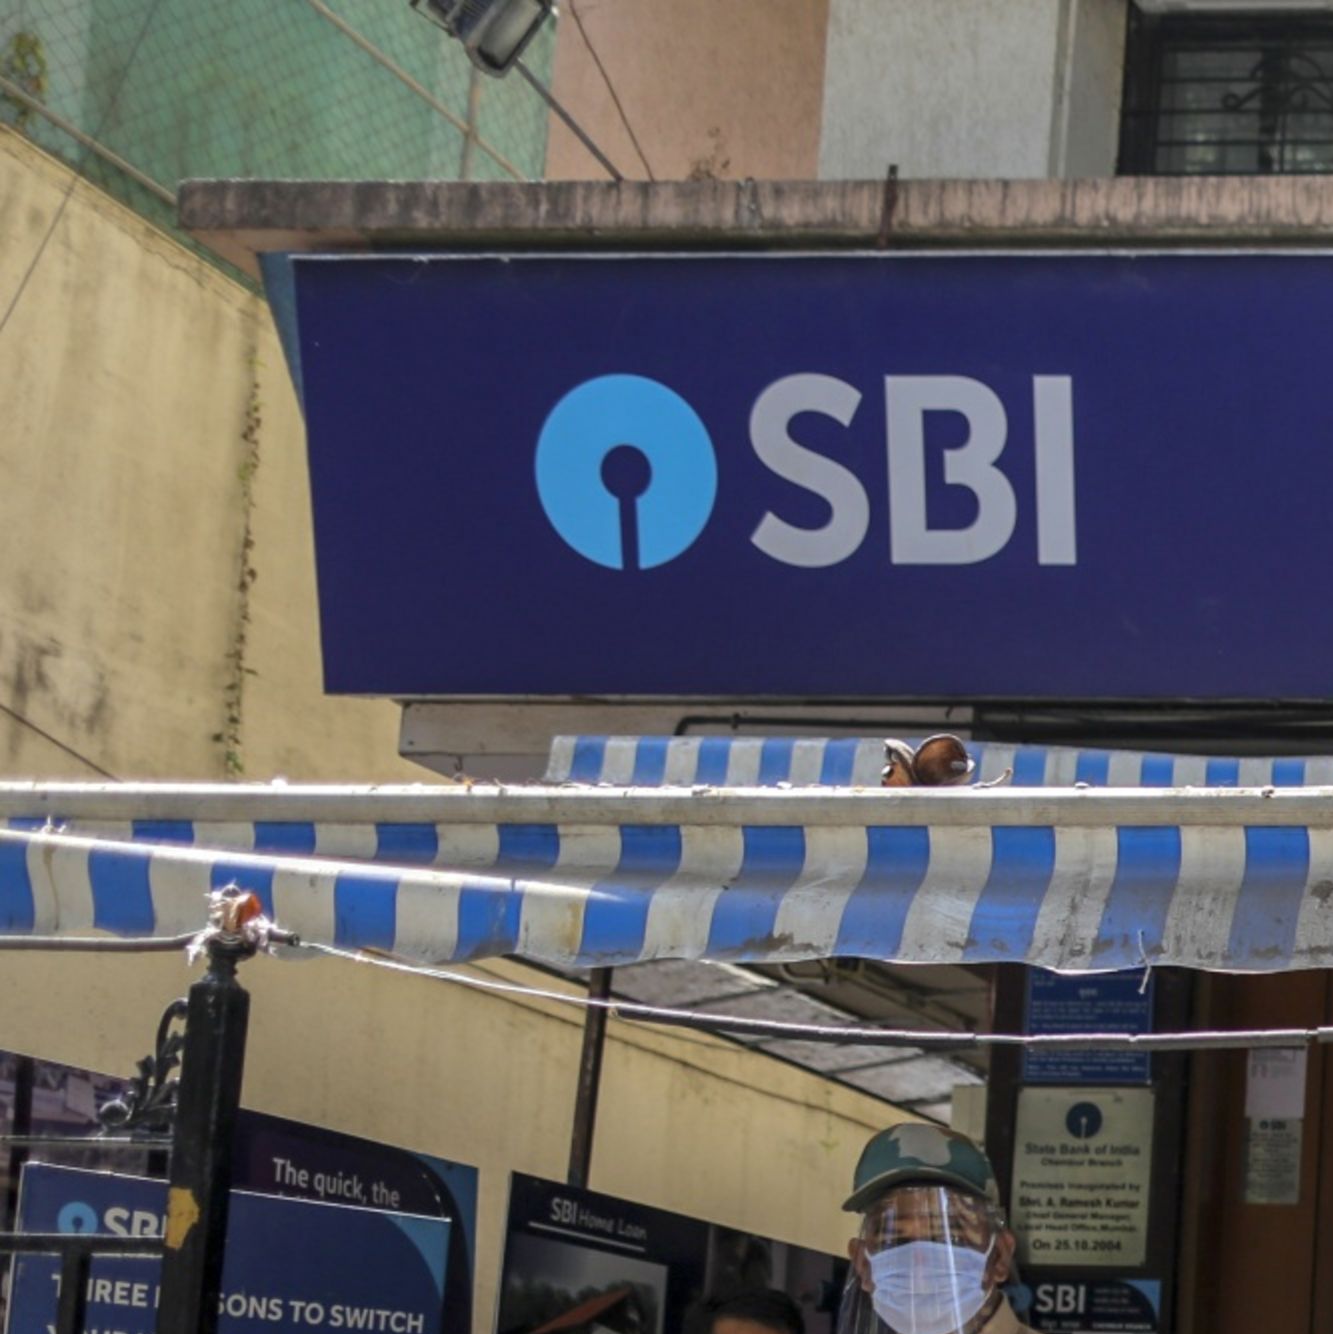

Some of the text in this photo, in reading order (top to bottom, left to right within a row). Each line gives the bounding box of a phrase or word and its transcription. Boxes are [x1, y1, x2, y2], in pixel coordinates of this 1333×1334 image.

[748, 372, 1077, 568] SBI
[1025, 1143, 1140, 1155] State Bank of India
[1041, 1157, 1122, 1167] Chembur Branch
[273, 1157, 400, 1208] The quick, the
[1060, 1197, 1101, 1208] Ramesh
[1105, 1198, 1140, 1209] Kumar
[551, 1198, 648, 1240] SBI Home Loan
[1033, 1239, 1050, 1251] On
[1035, 1284, 1086, 1314] SBI
[289, 1301, 325, 1325] TO
[329, 1305, 424, 1334] SWITCH
